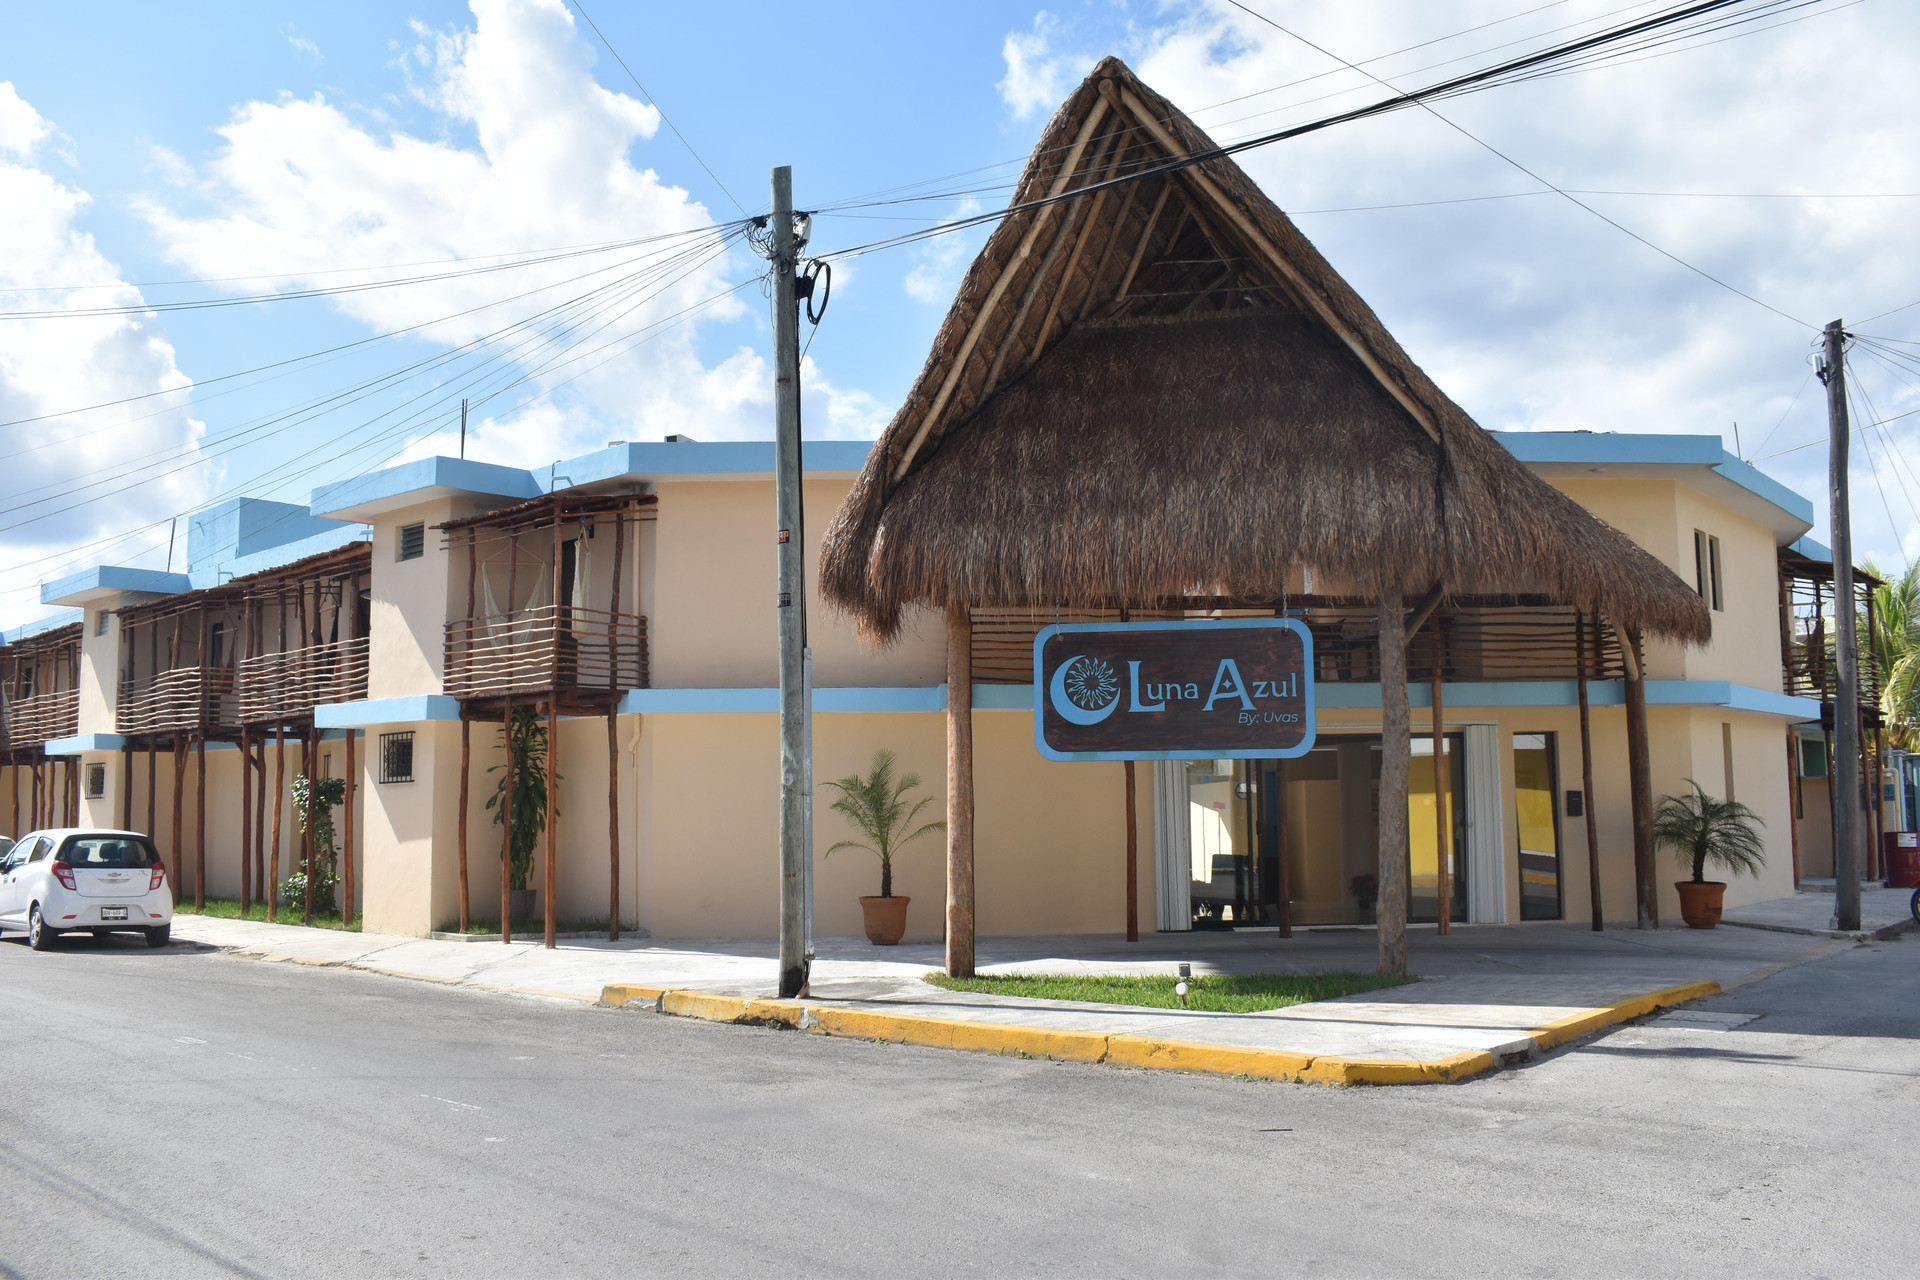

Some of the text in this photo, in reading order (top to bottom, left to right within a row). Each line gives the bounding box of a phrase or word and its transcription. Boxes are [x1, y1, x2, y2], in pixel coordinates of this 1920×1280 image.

[1128, 658, 1297, 712] Luna Azul
[1238, 711, 1298, 725] By: Uvas
